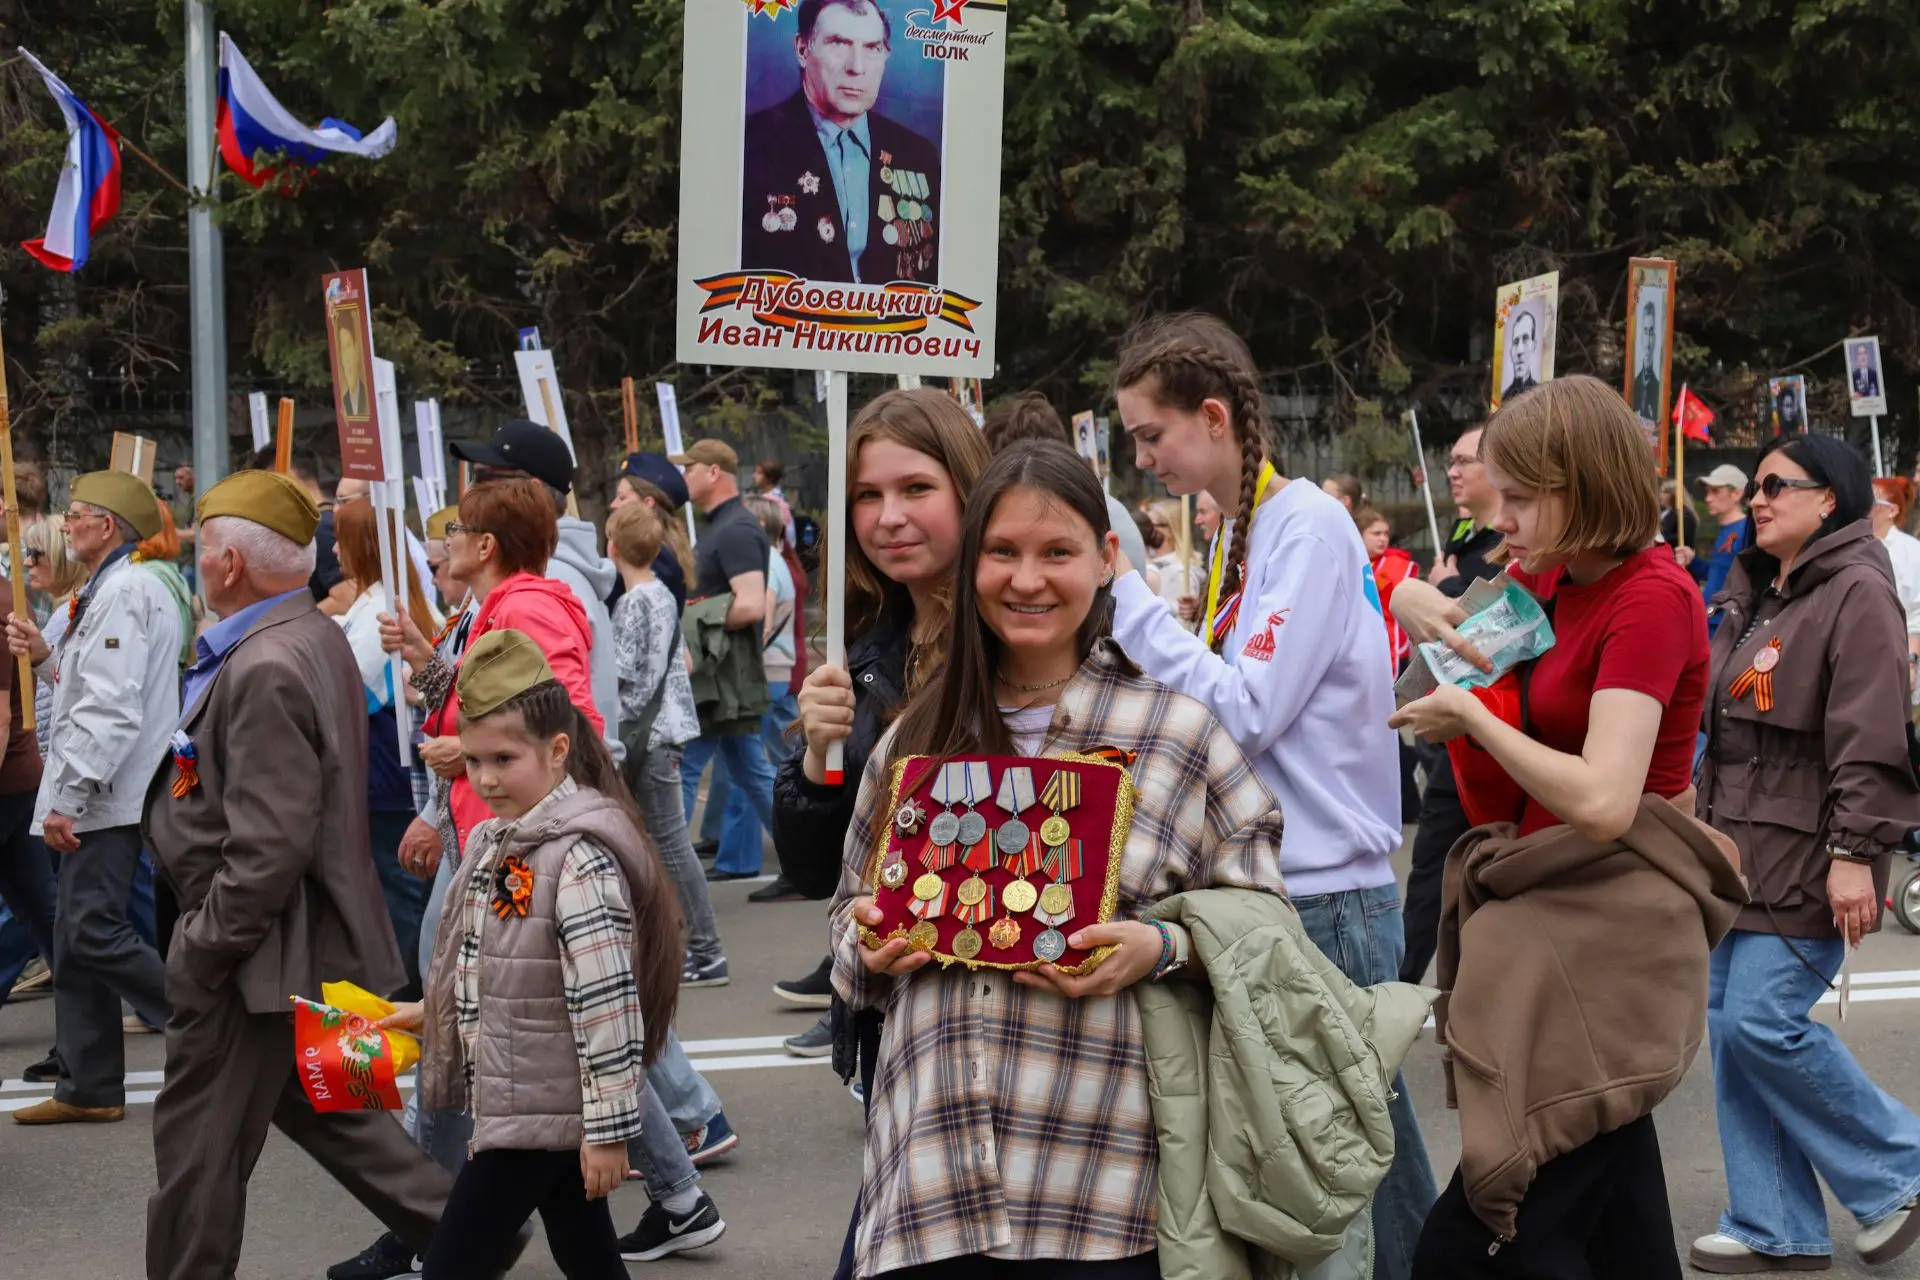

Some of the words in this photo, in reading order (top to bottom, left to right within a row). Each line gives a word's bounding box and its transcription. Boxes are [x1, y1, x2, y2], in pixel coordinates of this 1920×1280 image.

[924, 44, 969, 61] ПОЛК
[736, 278, 944, 318] Дубовицкий
[697, 317, 783, 349] Иван
[792, 322, 981, 358] Никитович
